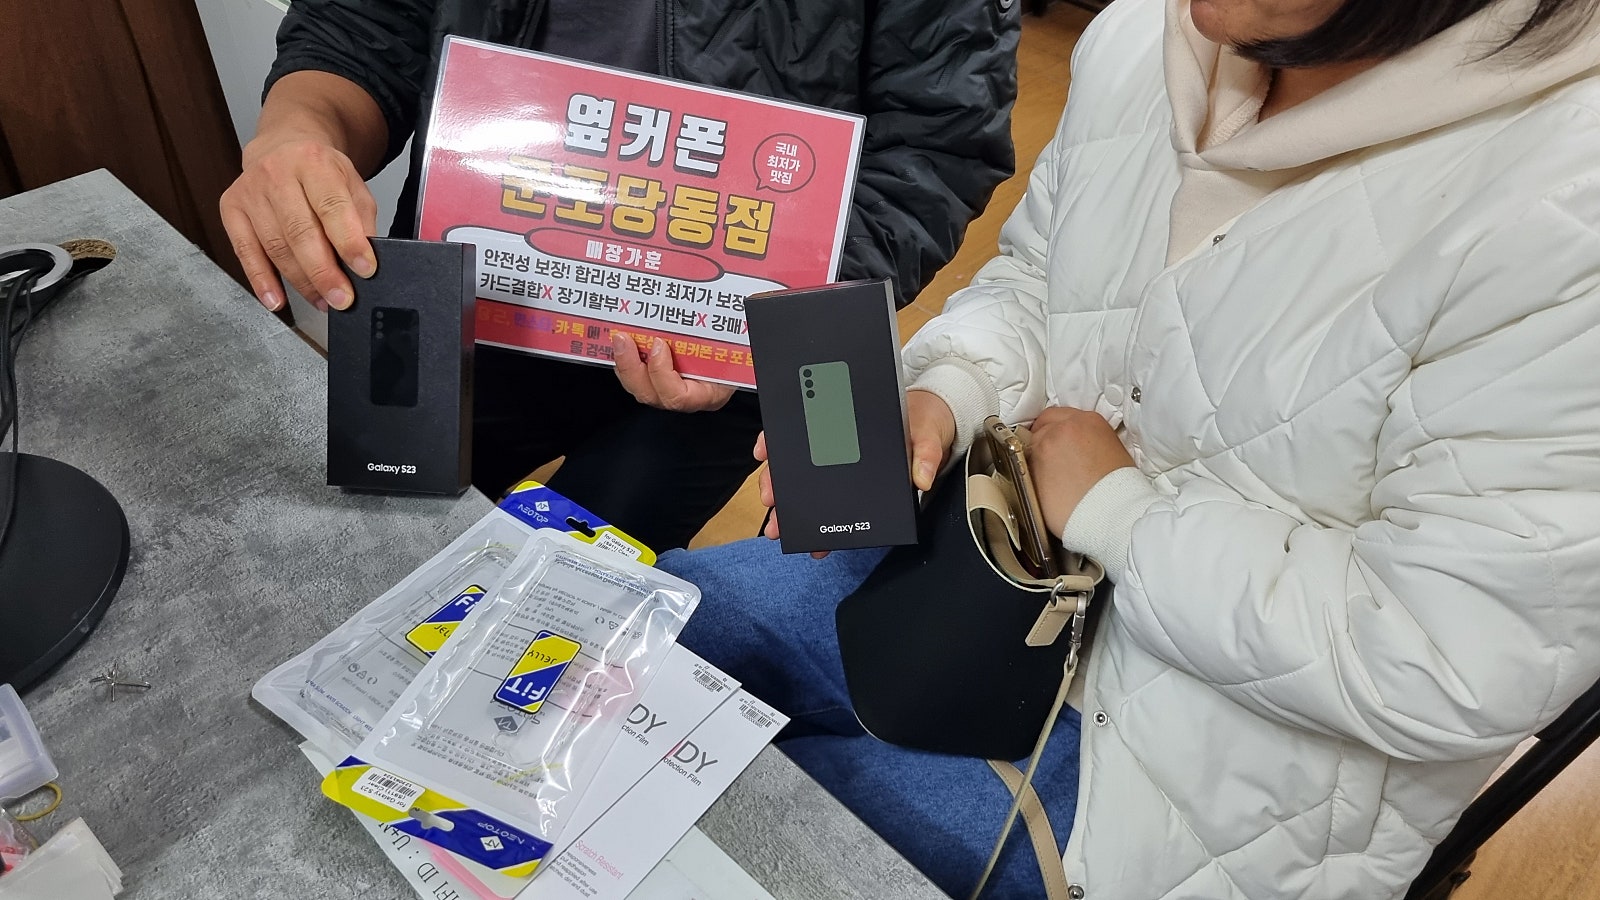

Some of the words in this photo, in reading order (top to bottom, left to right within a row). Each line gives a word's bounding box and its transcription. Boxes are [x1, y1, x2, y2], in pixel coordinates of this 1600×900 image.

[563, 93, 728, 178] 옆커폰
[775, 141, 798, 157] 국내
[767, 154, 800, 172] 최저가
[770, 169, 792, 185] 맛집
[501, 154, 776, 261] 군포당동점
[484, 248, 531, 273] 안전성
[534, 258, 571, 280] 보장!
[575, 265, 622, 289] 합리성
[625, 274, 662, 296] 보장!
[664, 281, 713, 306] 최저가
[480, 272, 554, 301] 카드결합X
[557, 286, 631, 315] 장기할부X
[634, 300, 708, 328] 기기반납X
[367, 463, 400, 474] Galaxy
[401, 465, 417, 474] S23
[517, 503, 549, 523] NEOTOP
[819, 523, 854, 533] Galaxy
[855, 522, 871, 531] S23
[527, 650, 557, 665] JELLY
[626, 703, 668, 734] DY
[636, 732, 650, 746] Film
[672, 740, 719, 774] DY
[687, 772, 702, 787] Film
[360, 785, 374, 794] S23
[374, 790, 396, 803] Galaxy
[477, 822, 526, 845] NEOTOP
[575, 839, 598, 860] Scratch
[598, 855, 624, 880] Resistant
[417, 862, 440, 884] ID
